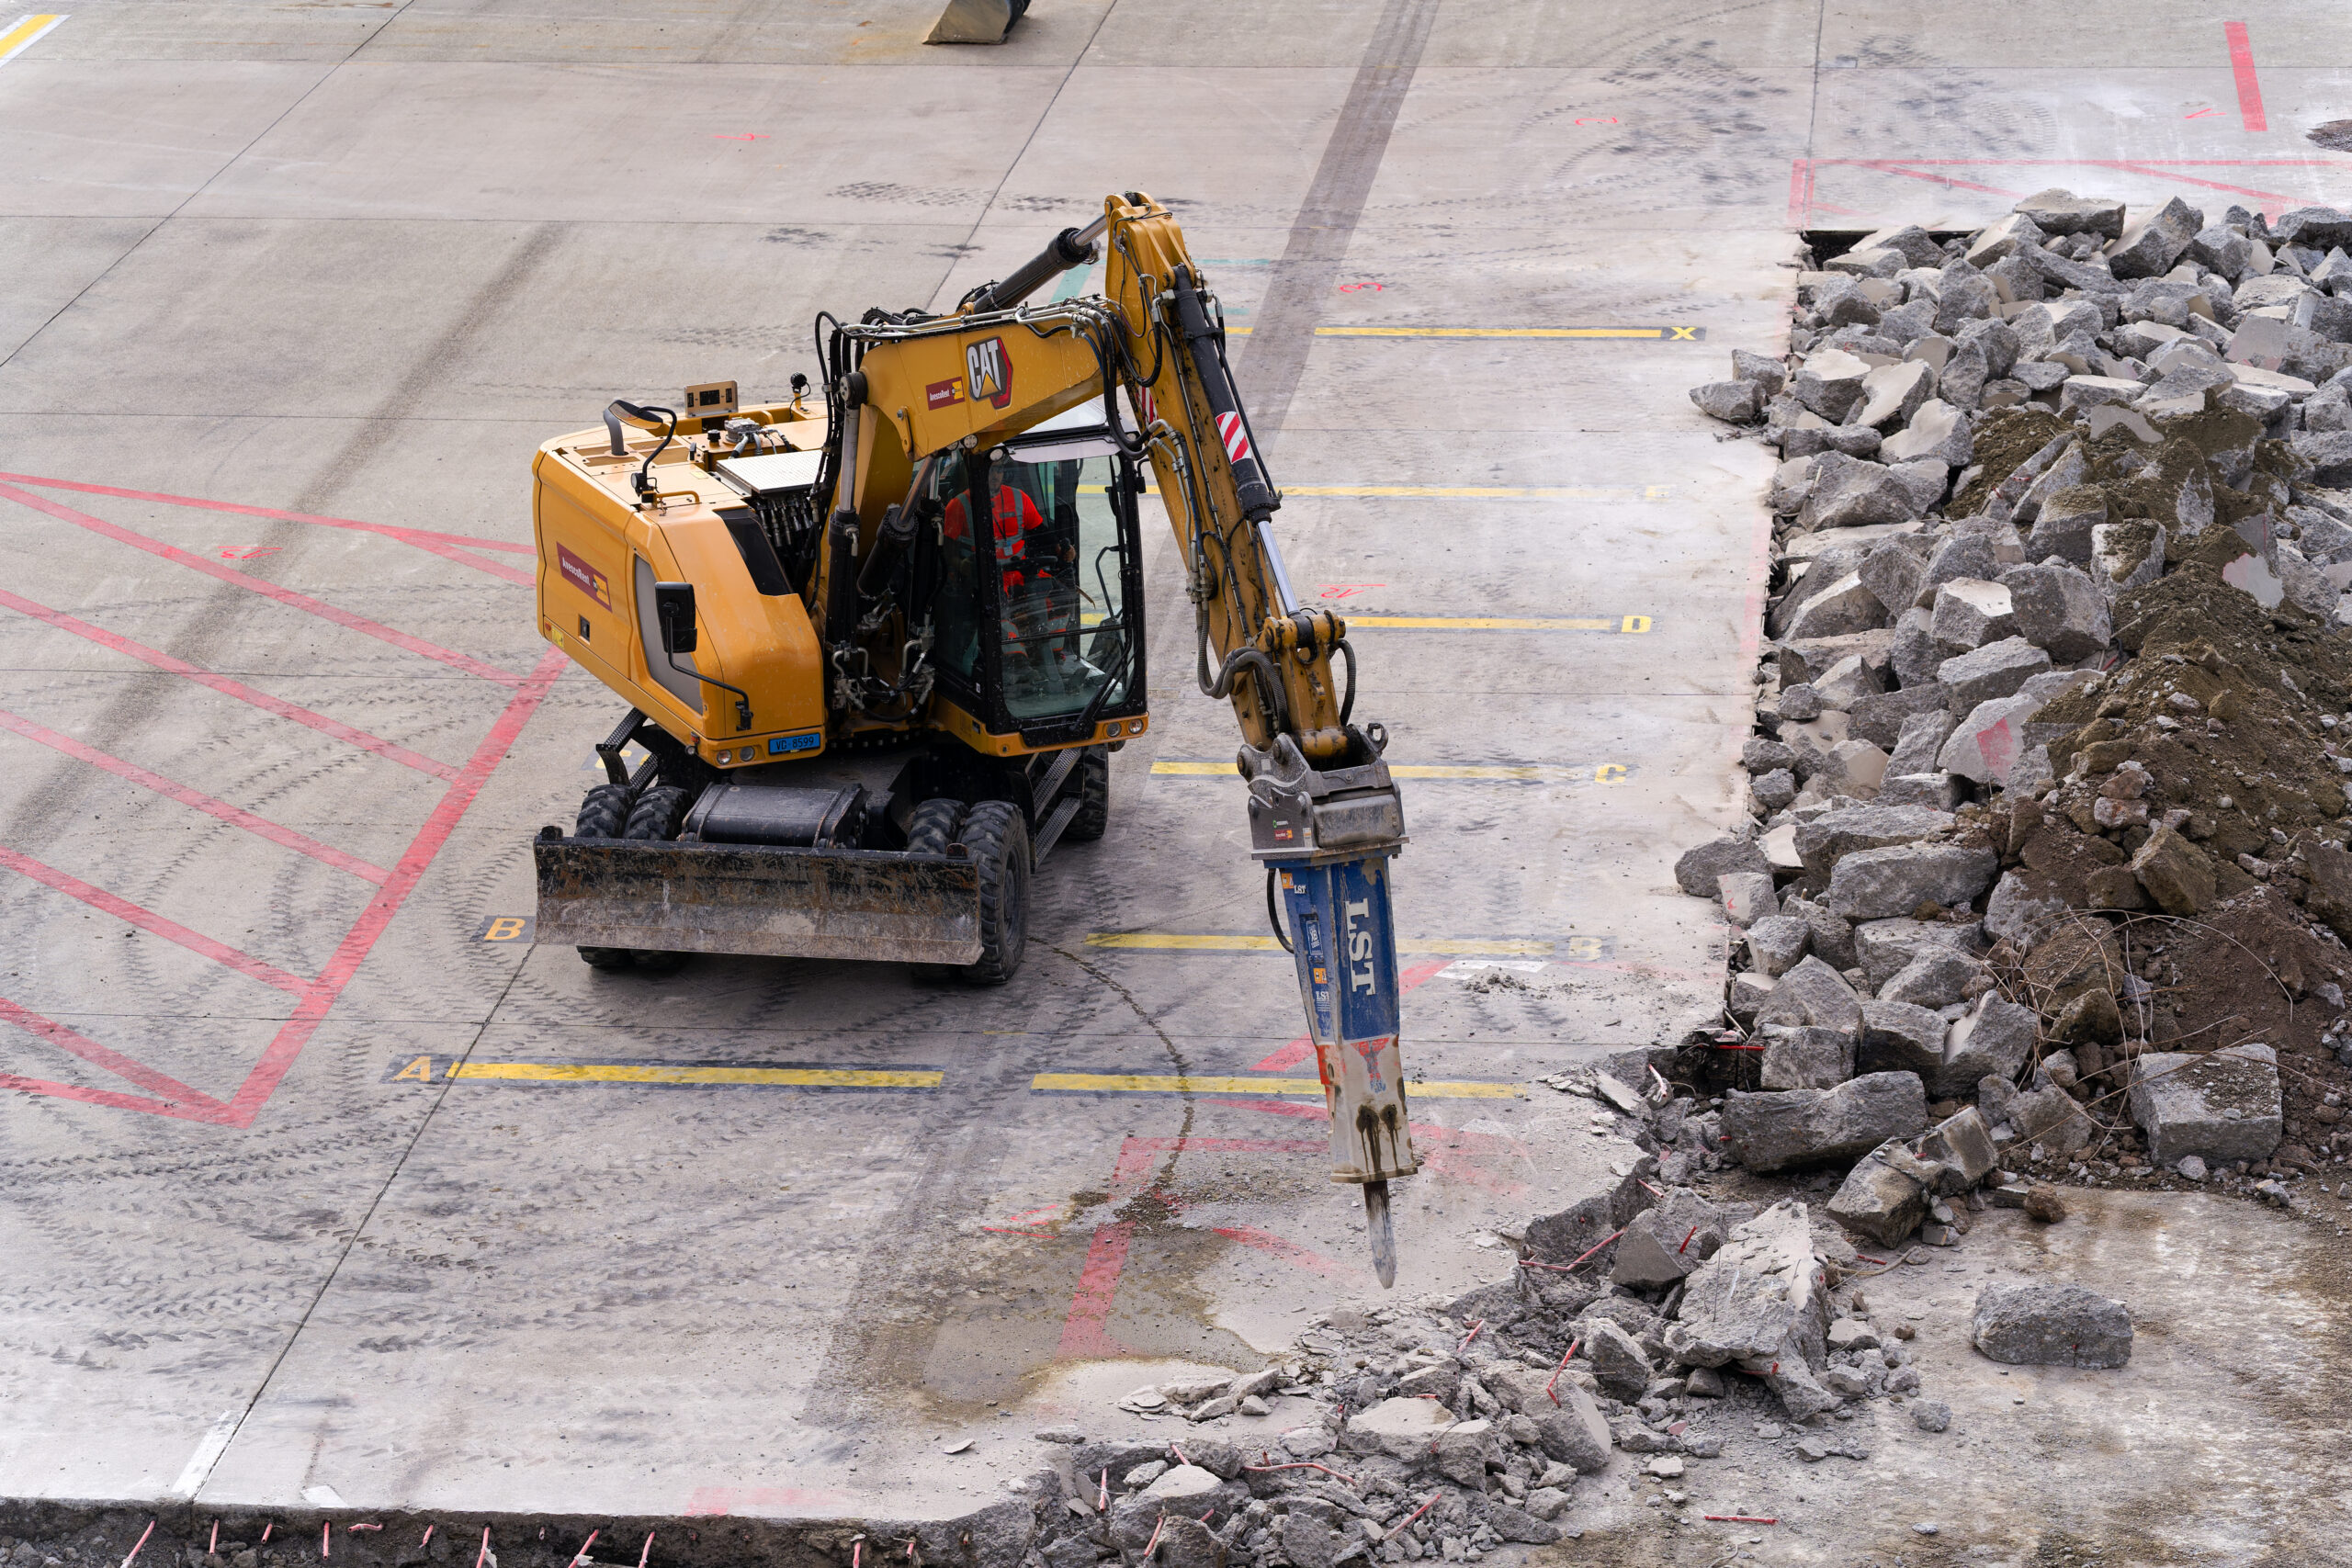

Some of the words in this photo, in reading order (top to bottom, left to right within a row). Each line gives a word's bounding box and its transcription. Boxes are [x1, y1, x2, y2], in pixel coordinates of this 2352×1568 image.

[1669, 326, 1698, 341] X
[967, 339, 1001, 399] CAT
[1621, 615, 1652, 633] D
[775, 739, 787, 750] VD
[792, 736, 815, 749] 8599
[1594, 763, 1627, 784] C
[1294, 884, 1306, 895] LST
[483, 917, 526, 941] B
[1345, 897, 1376, 997] LST
[1567, 936, 1603, 961] B
[390, 1055, 432, 1082] A
